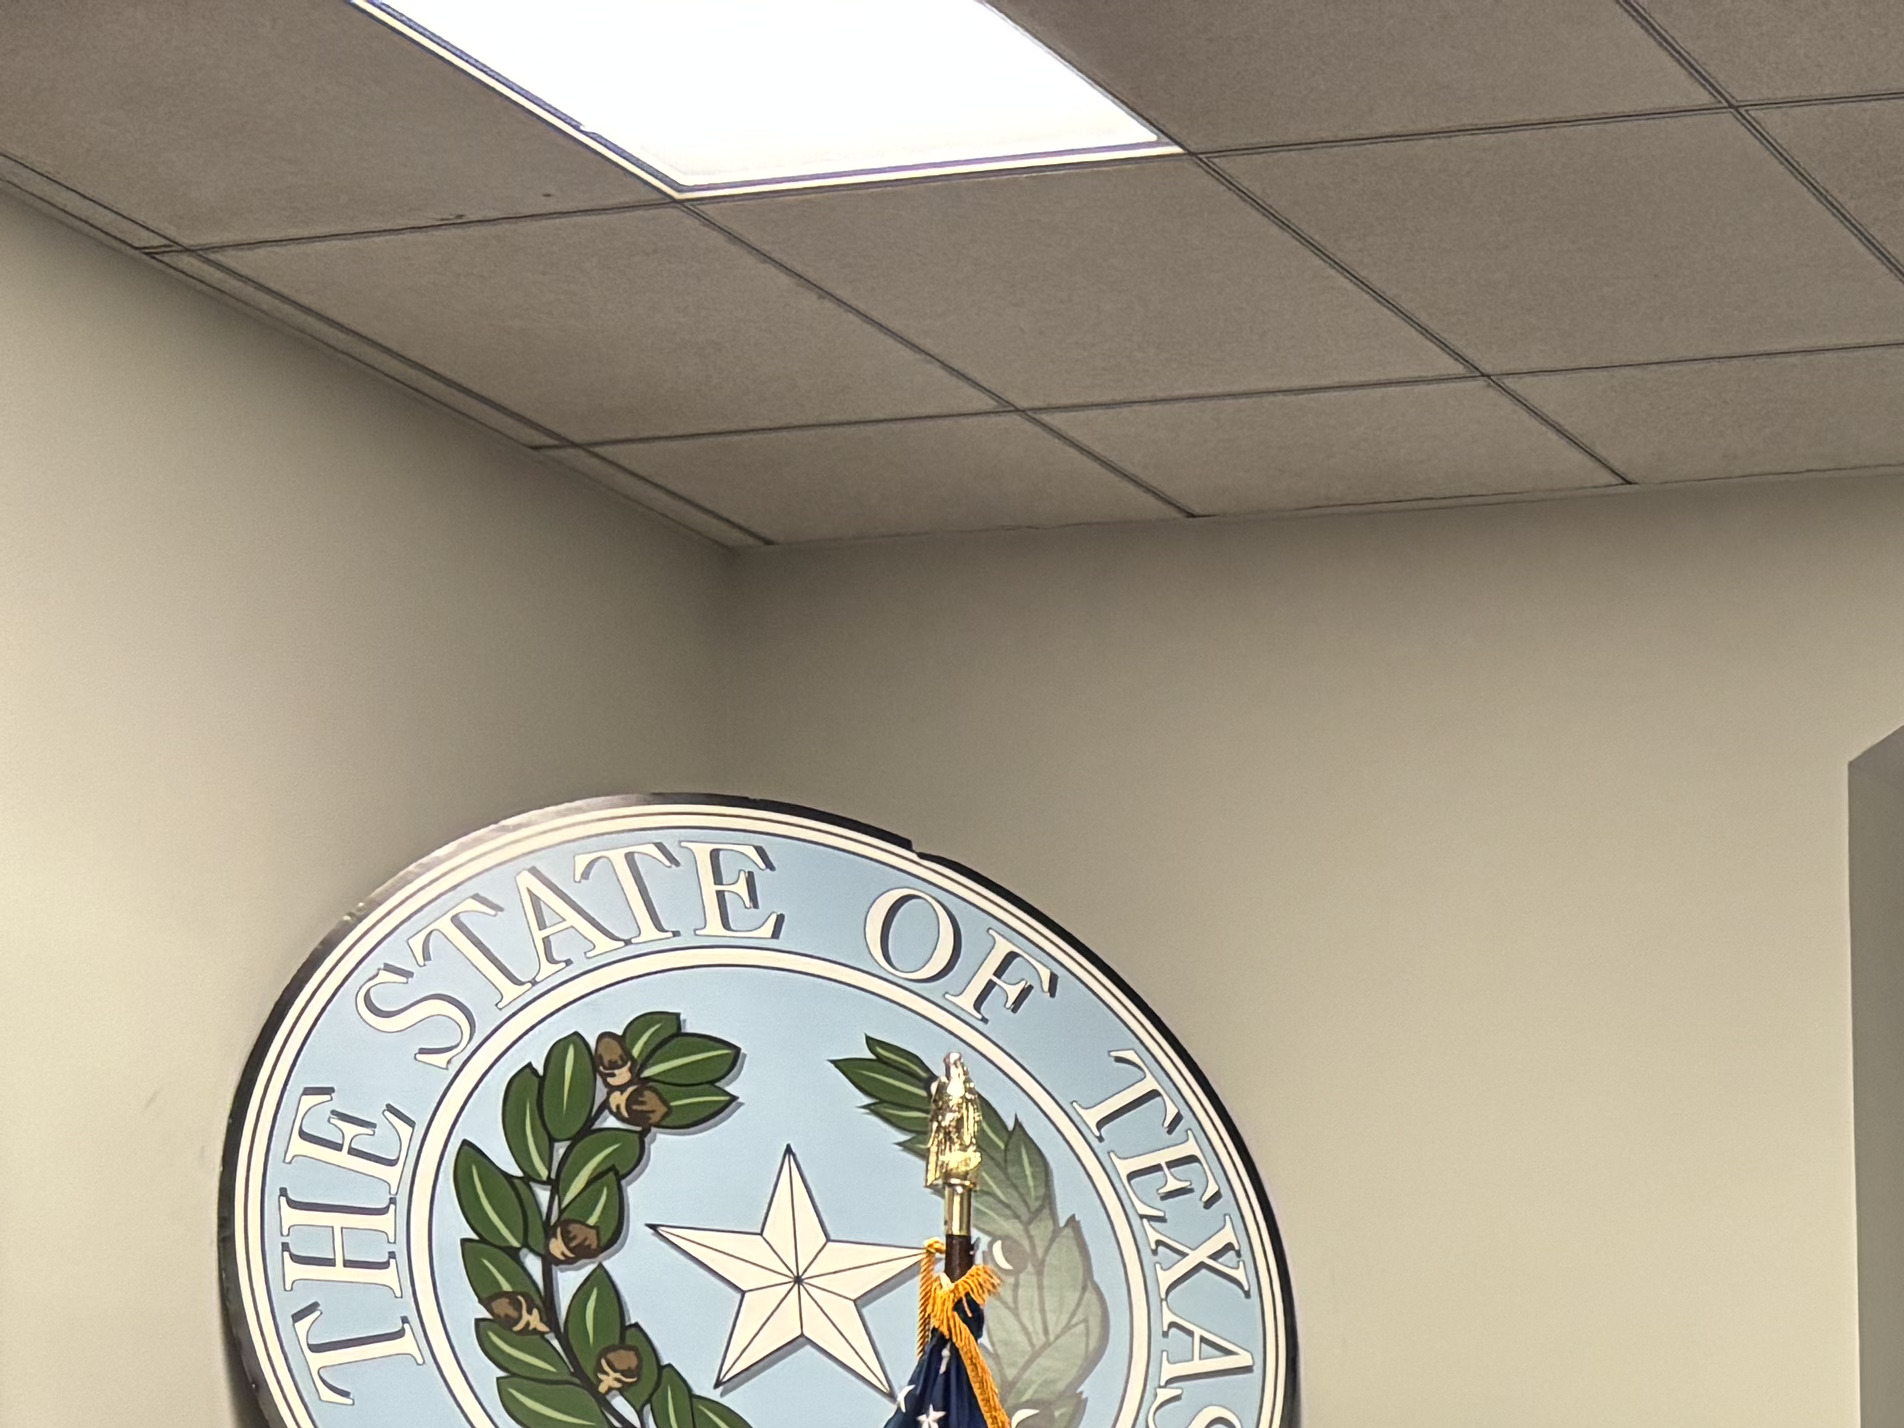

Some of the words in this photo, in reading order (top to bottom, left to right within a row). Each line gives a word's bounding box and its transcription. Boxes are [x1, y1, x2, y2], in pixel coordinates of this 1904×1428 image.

[280, 1087, 424, 1404] THE
[356, 841, 782, 1069] STATE
[865, 886, 1057, 1022] OF
